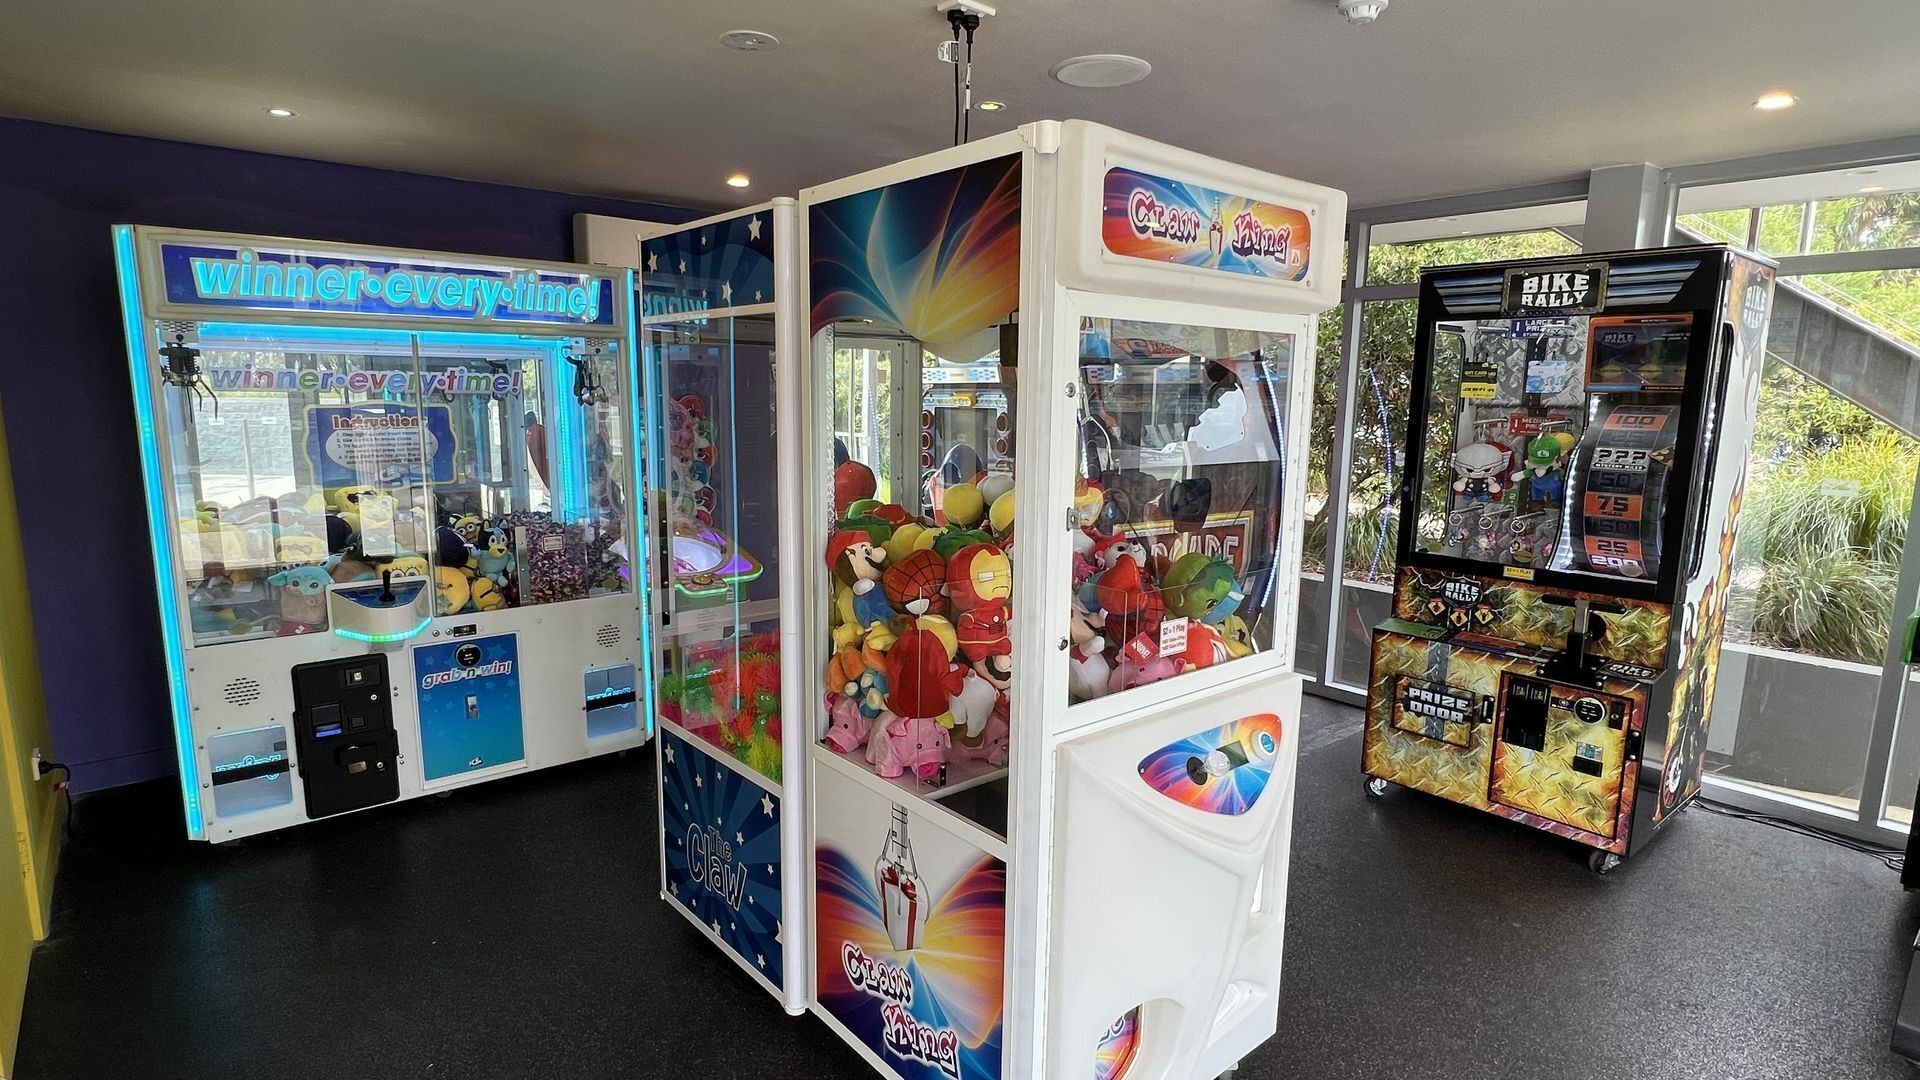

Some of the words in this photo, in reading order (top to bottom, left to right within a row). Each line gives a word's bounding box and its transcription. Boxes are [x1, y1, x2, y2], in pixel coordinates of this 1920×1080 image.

[1522, 272, 1590, 294] BIKE
[1521, 290, 1588, 307] RALLY
[1744, 285, 1767, 311] BIKE
[1597, 495, 1629, 512] 75
[1597, 540, 1629, 554] 25
[1445, 582, 1480, 595] BIKE
[1445, 591, 1478, 602] RALLY
[1408, 686, 1469, 711] PRIZE
[1409, 700, 1464, 723] DOOR
[707, 825, 732, 862] The
[686, 823, 748, 911] Claw
